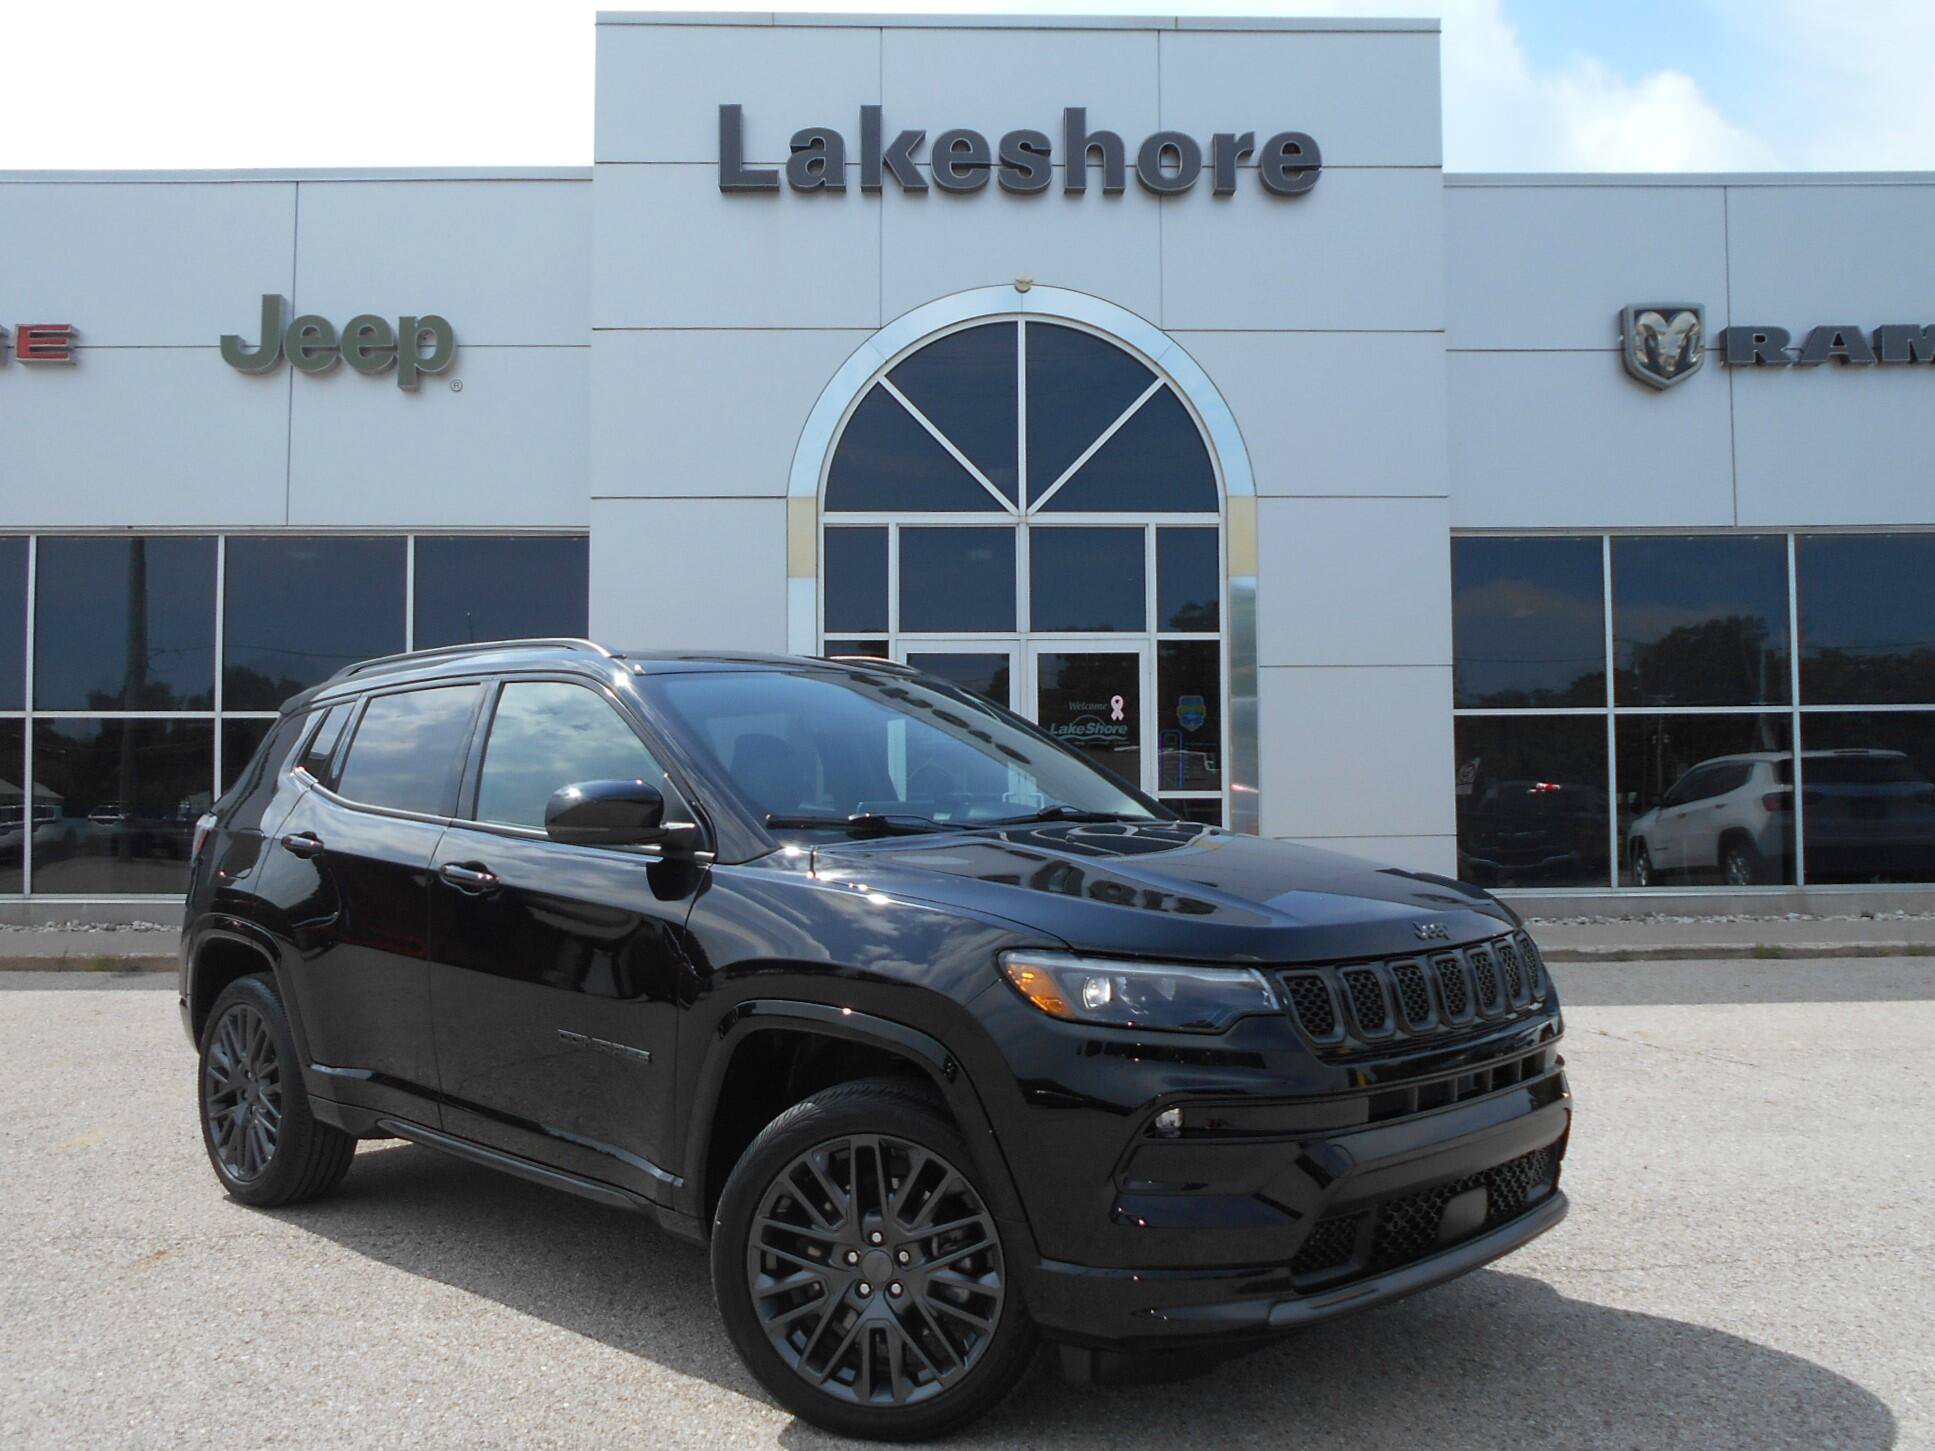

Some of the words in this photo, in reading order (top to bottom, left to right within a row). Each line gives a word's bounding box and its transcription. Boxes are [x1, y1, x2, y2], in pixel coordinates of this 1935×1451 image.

[718, 104, 1323, 196] Lakeshore
[0, 324, 79, 367] E
[220, 293, 457, 390] Jeep
[1068, 701, 1108, 711] Welcome
[1049, 722, 1128, 735] LakeShore
